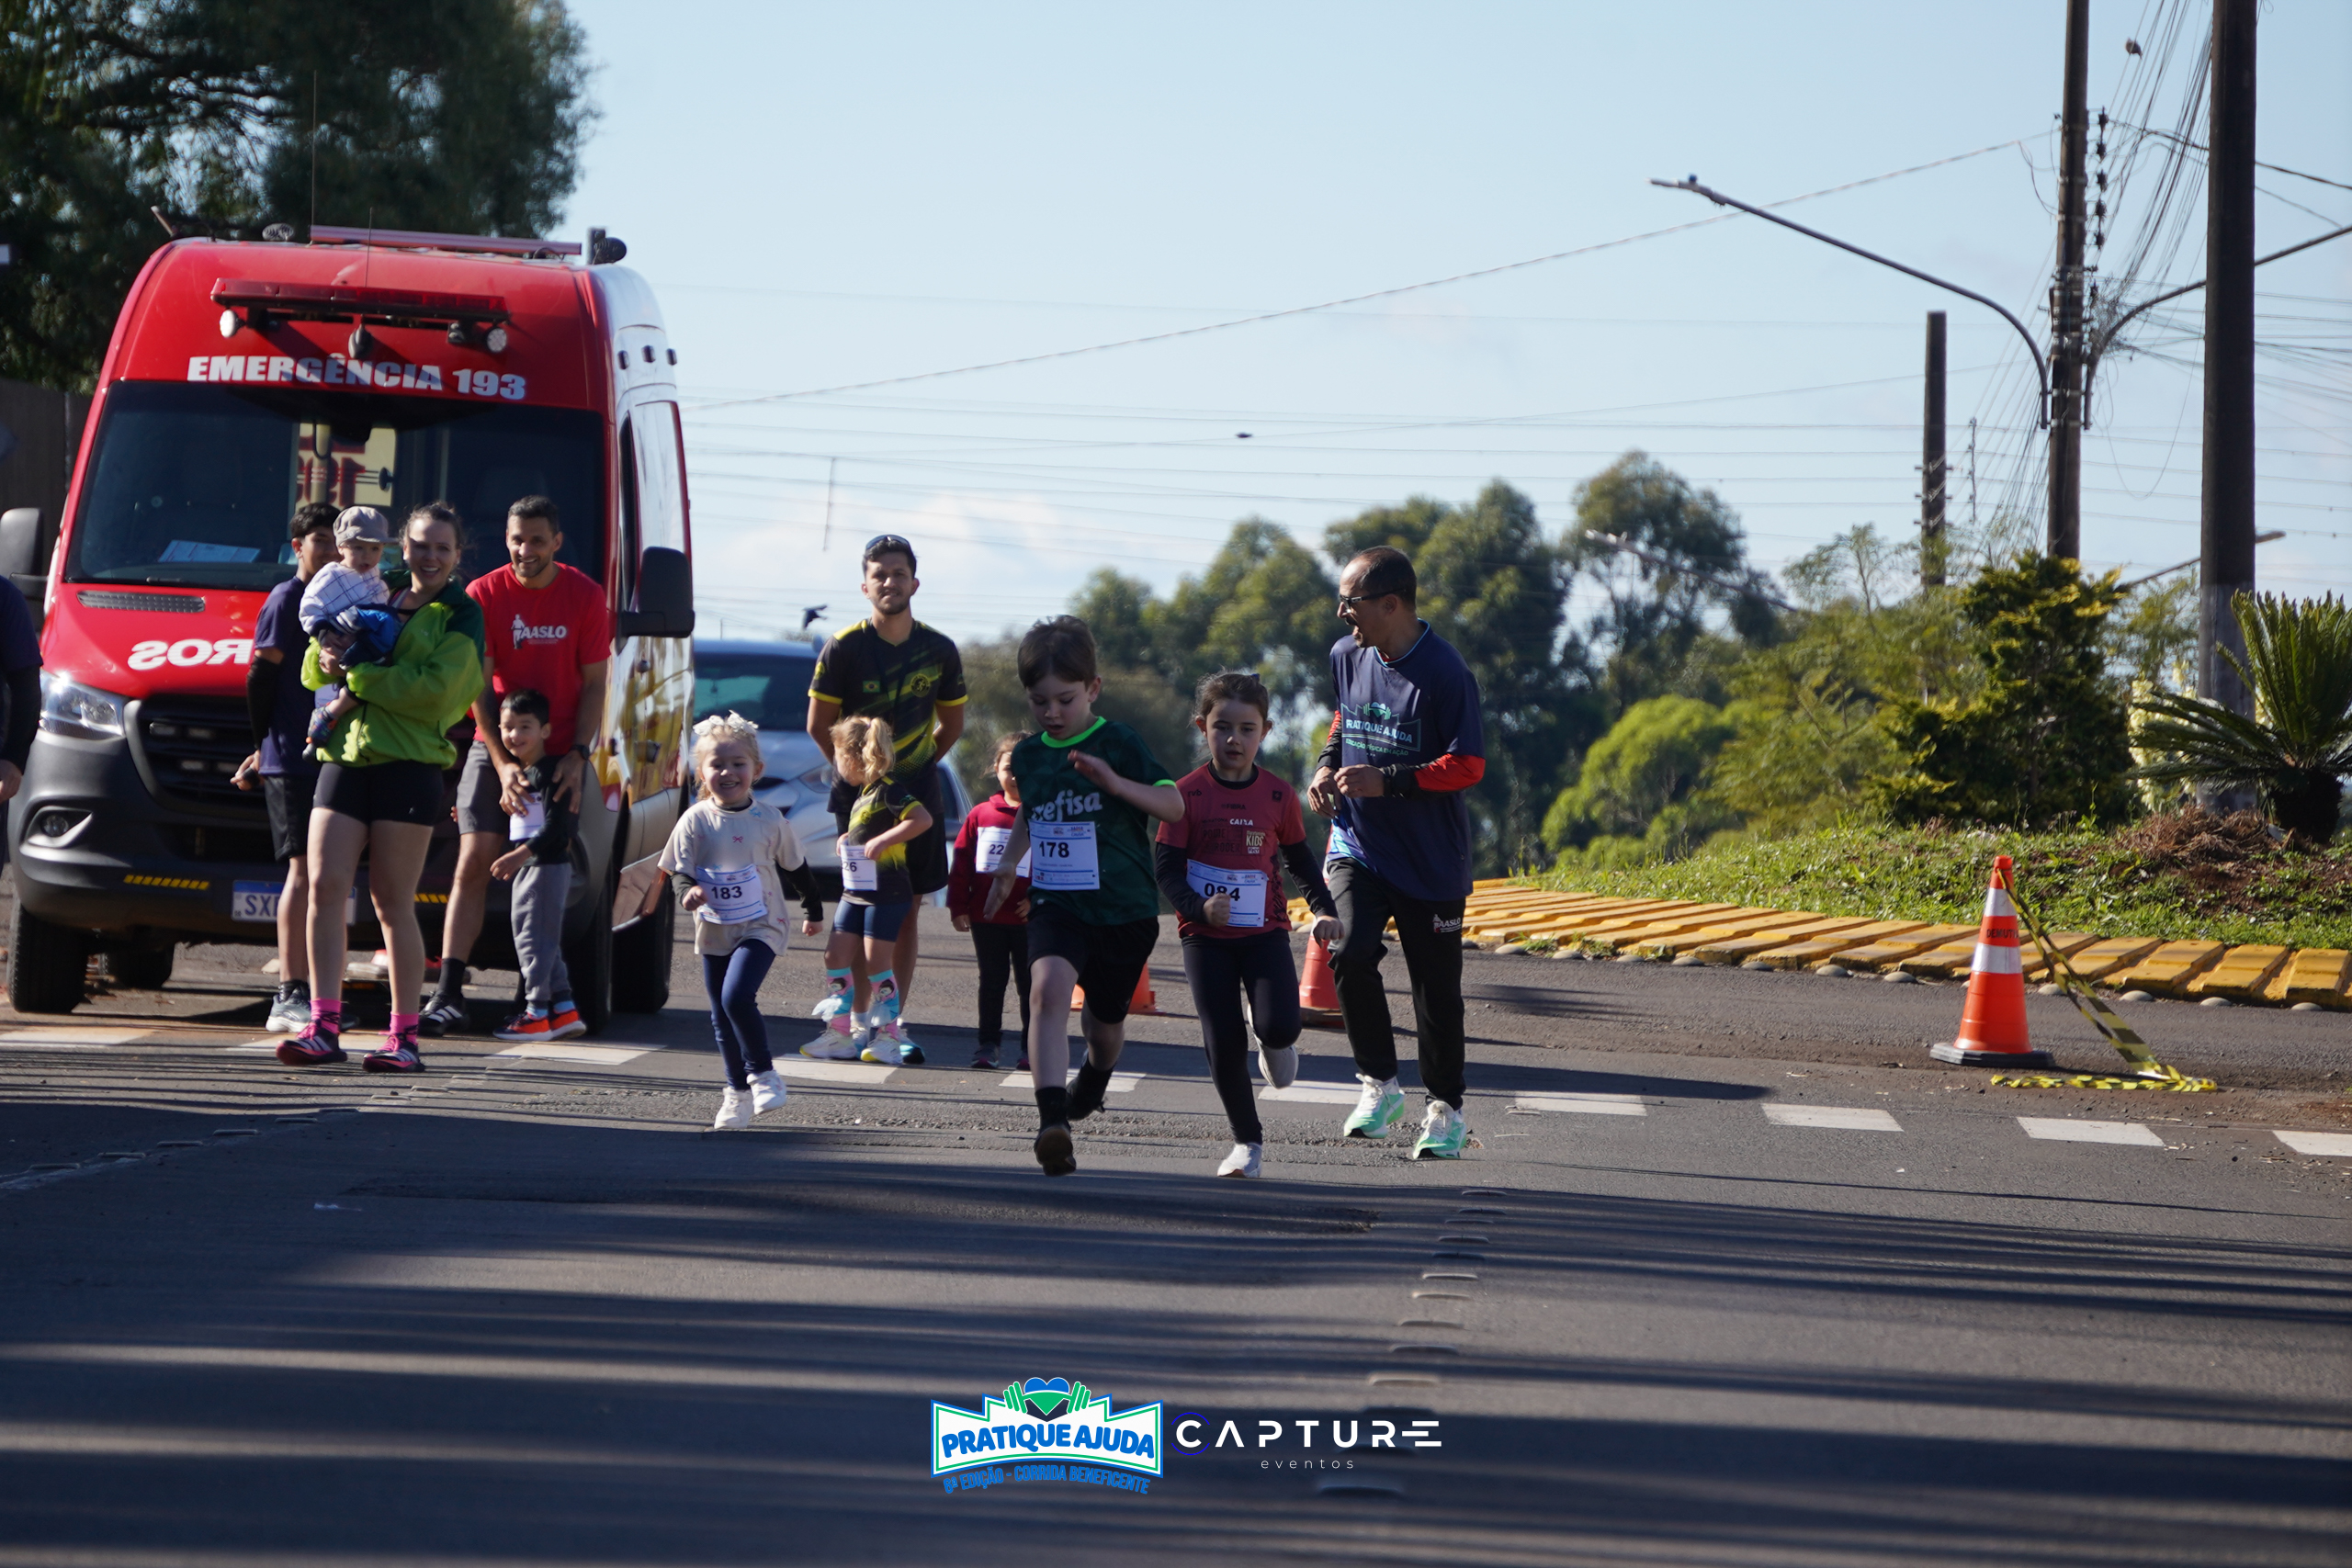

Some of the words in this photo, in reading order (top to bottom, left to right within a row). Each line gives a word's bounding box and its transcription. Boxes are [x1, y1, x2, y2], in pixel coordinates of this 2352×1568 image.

[187, 352, 443, 390] EMERGÊNCIA
[452, 368, 526, 400] 193
[520, 625, 567, 639] AASLO
[1383, 726, 1413, 743] AJUDA
[1031, 789, 1103, 822] refisa
[1246, 835, 1265, 846] KIDS
[989, 844, 1005, 855] 22
[1039, 840, 1070, 858] 178
[842, 862, 858, 873] 26
[711, 886, 742, 900] 183
[1204, 883, 1240, 902] 084
